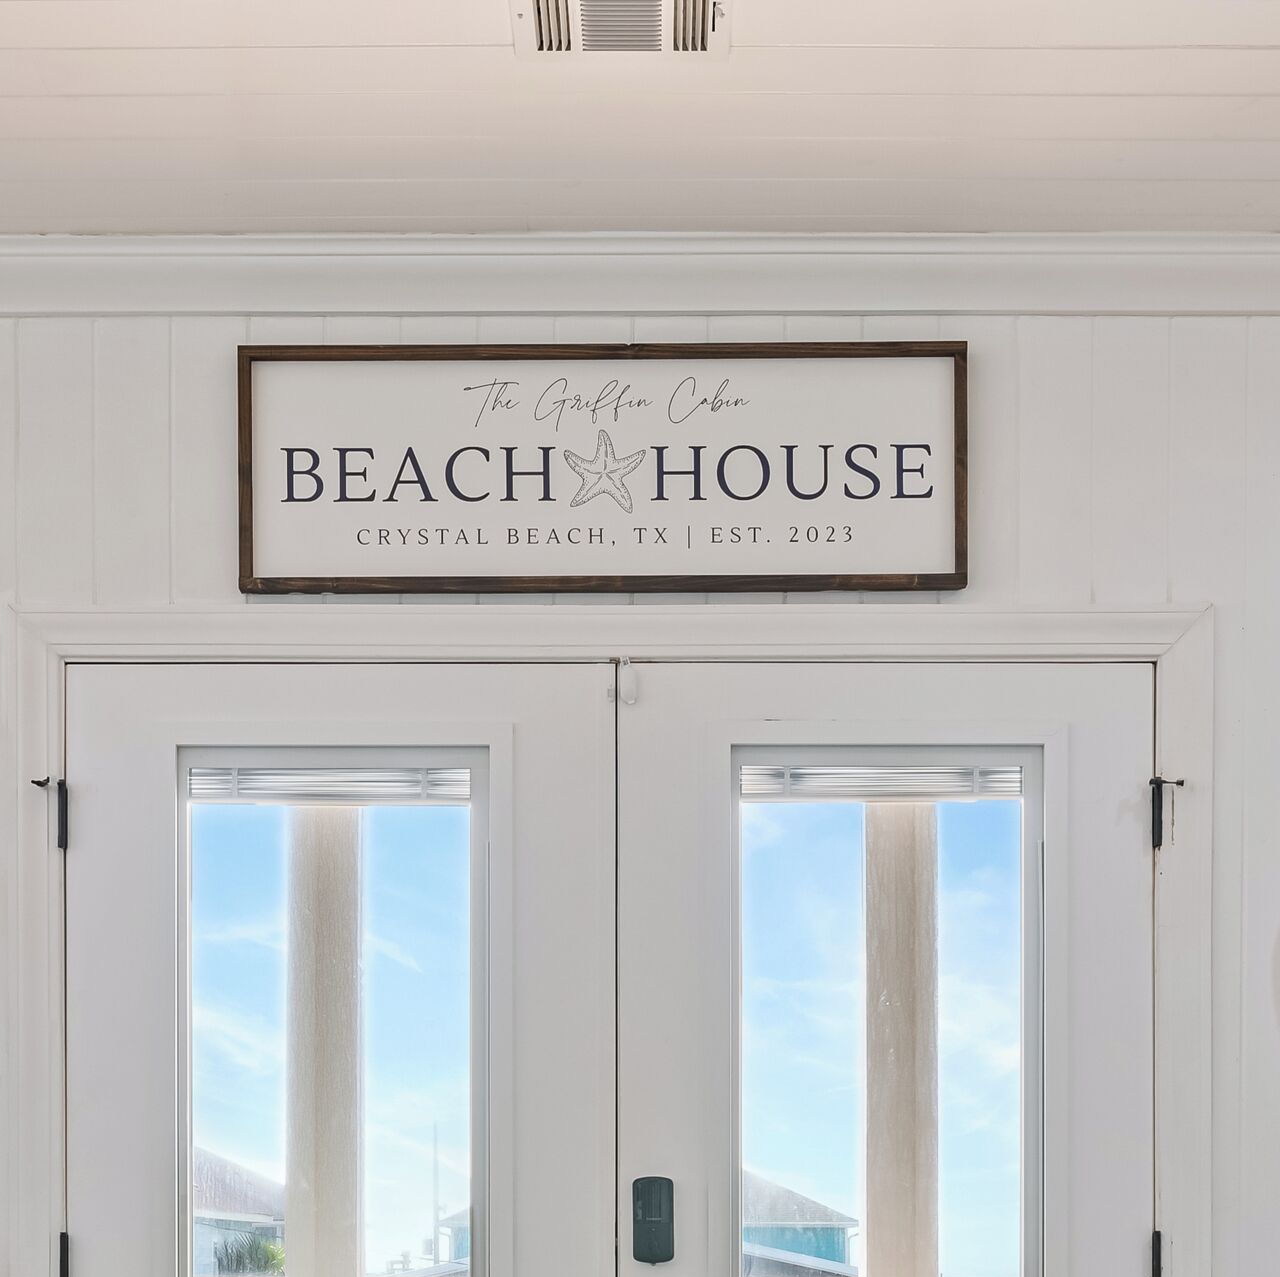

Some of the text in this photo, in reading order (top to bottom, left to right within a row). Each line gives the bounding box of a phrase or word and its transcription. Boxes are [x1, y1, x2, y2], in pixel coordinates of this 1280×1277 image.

[463, 376, 750, 432] The Griffin Cabin
[279, 443, 934, 503] BEACH HOUSE
[356, 527, 489, 546] CRYSTAL
[507, 527, 617, 547] BEACH,
[633, 527, 669, 544] TX
[710, 526, 771, 544] EST.
[789, 525, 854, 543] 2023
